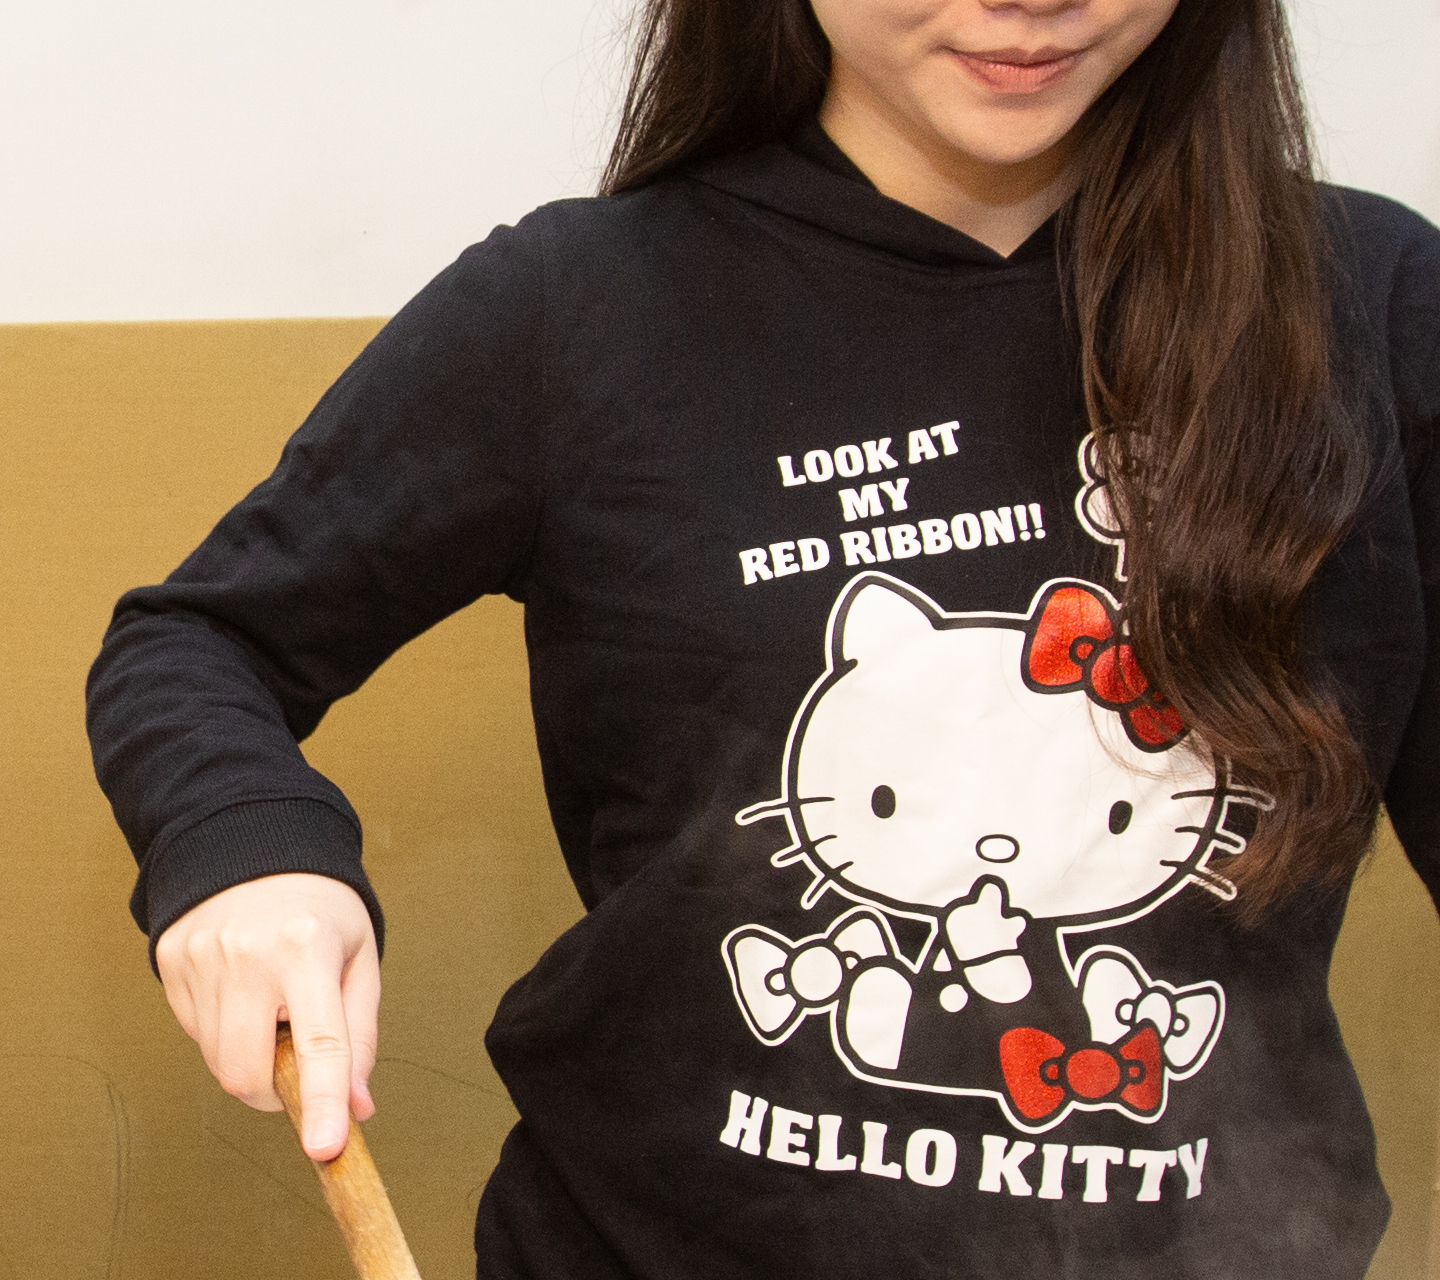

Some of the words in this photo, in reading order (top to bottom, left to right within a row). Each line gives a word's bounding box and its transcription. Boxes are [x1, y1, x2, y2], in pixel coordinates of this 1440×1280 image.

[775, 430, 899, 488] LOOK
[906, 419, 962, 467] AT
[837, 477, 911, 523] MY
[738, 529, 832, 586] RED
[842, 503, 1048, 568] RIBBON!!
[719, 1089, 959, 1189] HELLO
[977, 1135, 1210, 1205] KITTY
